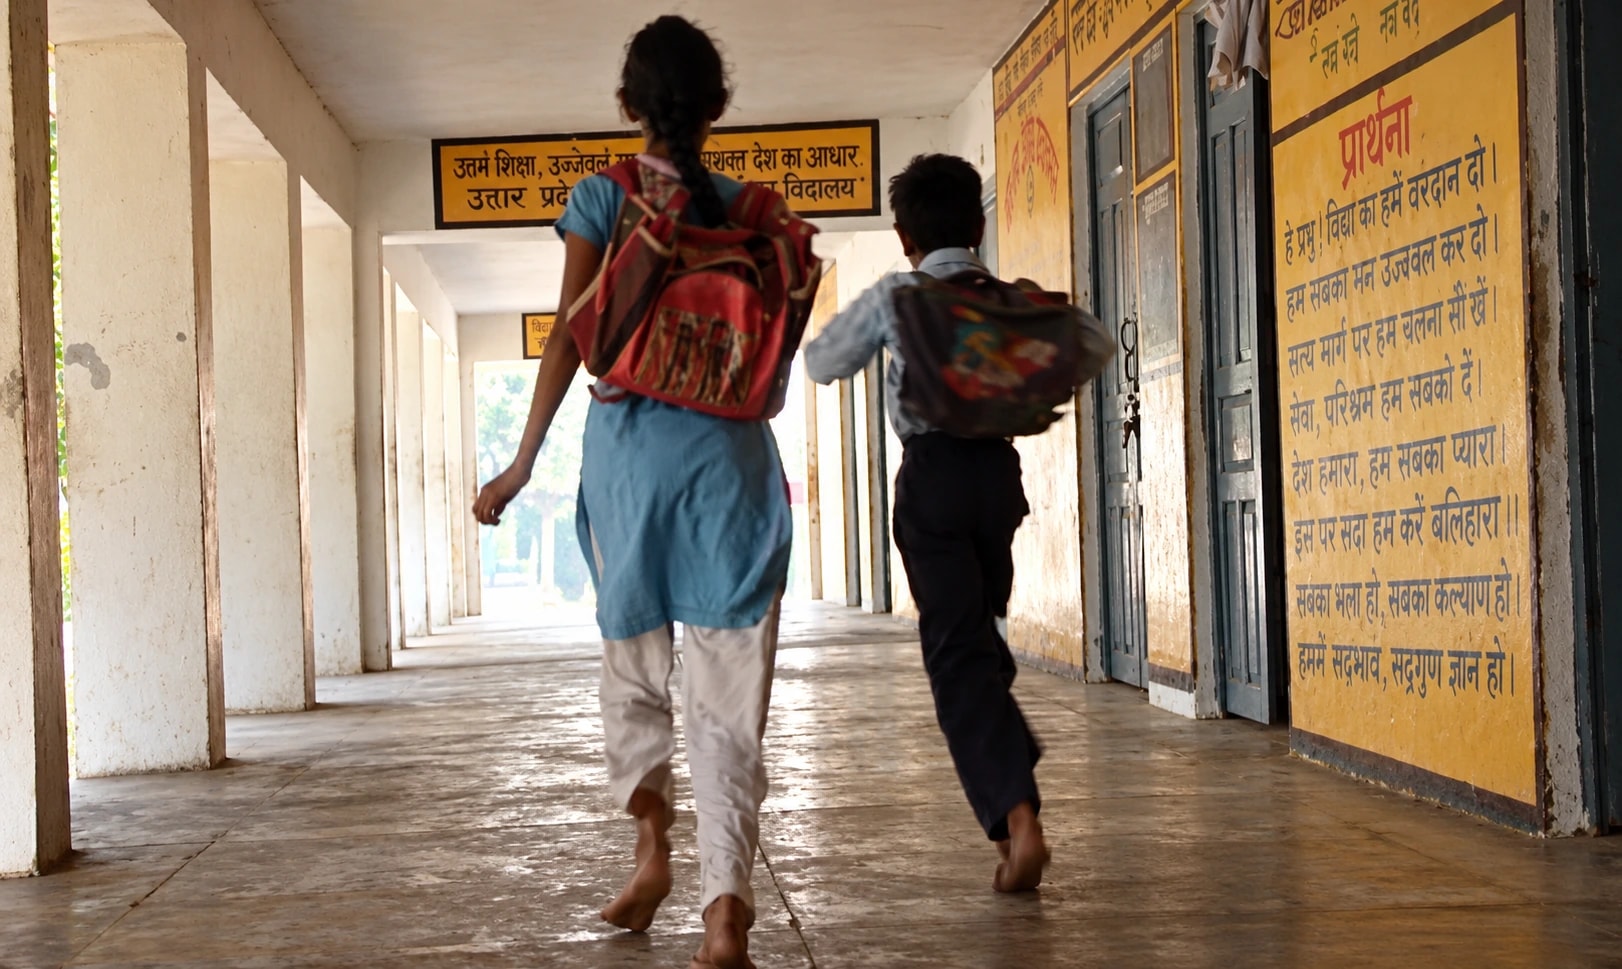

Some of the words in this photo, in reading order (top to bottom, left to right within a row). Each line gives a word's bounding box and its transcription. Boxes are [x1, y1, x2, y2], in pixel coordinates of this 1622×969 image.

[494, 148, 543, 180] शिक्षा,
[752, 141, 778, 173] देश
[781, 147, 803, 169] का
[1339, 87, 1413, 191] प्रार्थना
[539, 179, 574, 209] प्रदे
[1284, 220, 1294, 266] हे
[1326, 199, 1356, 245] विद्या
[1359, 193, 1378, 230] का
[1380, 170, 1403, 228] हमें
[1407, 157, 1462, 211] वरदान
[1286, 283, 1306, 323] हम
[1309, 267, 1348, 311] सबका
[1352, 257, 1377, 295] मन
[1440, 225, 1466, 267] कर
[1288, 340, 1315, 378] सत्य
[1320, 316, 1347, 368] मार्ग
[1351, 322, 1372, 360] पर
[1375, 314, 1398, 359] हम
[1401, 301, 1443, 345] चलना
[1289, 391, 1320, 440] सेवा,
[1324, 378, 1376, 427] परिश्रम
[1380, 377, 1404, 422] हम
[1408, 353, 1455, 412] सबको
[1291, 449, 1314, 498] देश
[1318, 451, 1365, 496] हमारा,
[1368, 446, 1393, 490] हम
[1397, 435, 1446, 481] सबका
[1293, 519, 1315, 562] इस
[1318, 517, 1337, 552] पर
[1340, 513, 1368, 556] सदा
[1372, 510, 1396, 555] हम
[1400, 492, 1426, 546] करें
[1296, 584, 1332, 620] सबका
[1334, 582, 1362, 621] भला
[1388, 579, 1432, 618] सबका
[1434, 575, 1492, 618] कल्याण
[1298, 631, 1327, 681] हममें
[1448, 650, 1482, 697] ज्ञान
